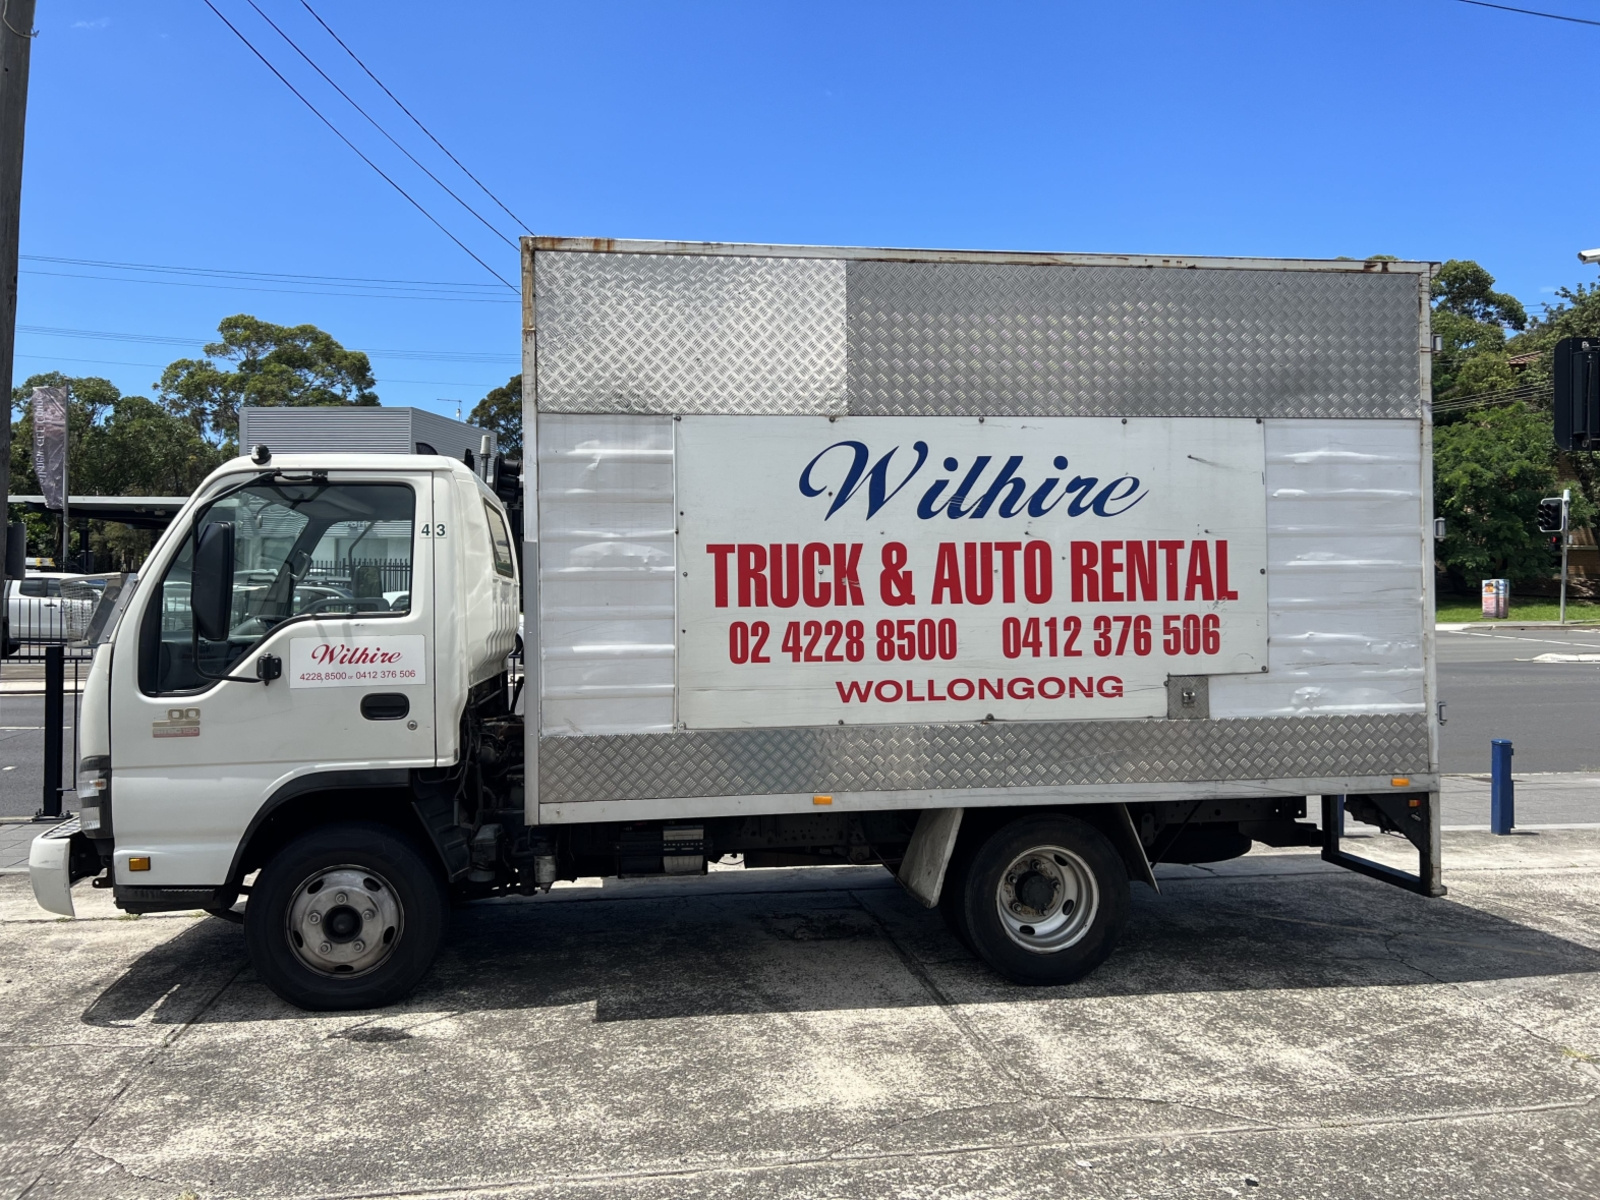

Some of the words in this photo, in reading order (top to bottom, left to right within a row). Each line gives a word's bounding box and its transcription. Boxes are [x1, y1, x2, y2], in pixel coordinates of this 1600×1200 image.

[800, 441, 1148, 520] Wilhire
[421, 523, 446, 537] 43
[706, 542, 864, 609] TRUCK
[880, 542, 917, 607] &
[932, 540, 1053, 606] AUTO
[1071, 540, 1239, 603] RENTAL
[729, 620, 771, 665] 02
[782, 619, 865, 663] 4228
[876, 618, 958, 663] 8500
[1002, 615, 1083, 660] 0412
[1094, 614, 1153, 658] 376
[1163, 613, 1221, 657] 506
[311, 643, 403, 666] Wilhire
[325, 671, 347, 680] 8500
[356, 671, 378, 679] 0412
[381, 670, 397, 678] 376
[399, 669, 416, 678] 506
[836, 676, 1124, 704] WOLLONGONG
